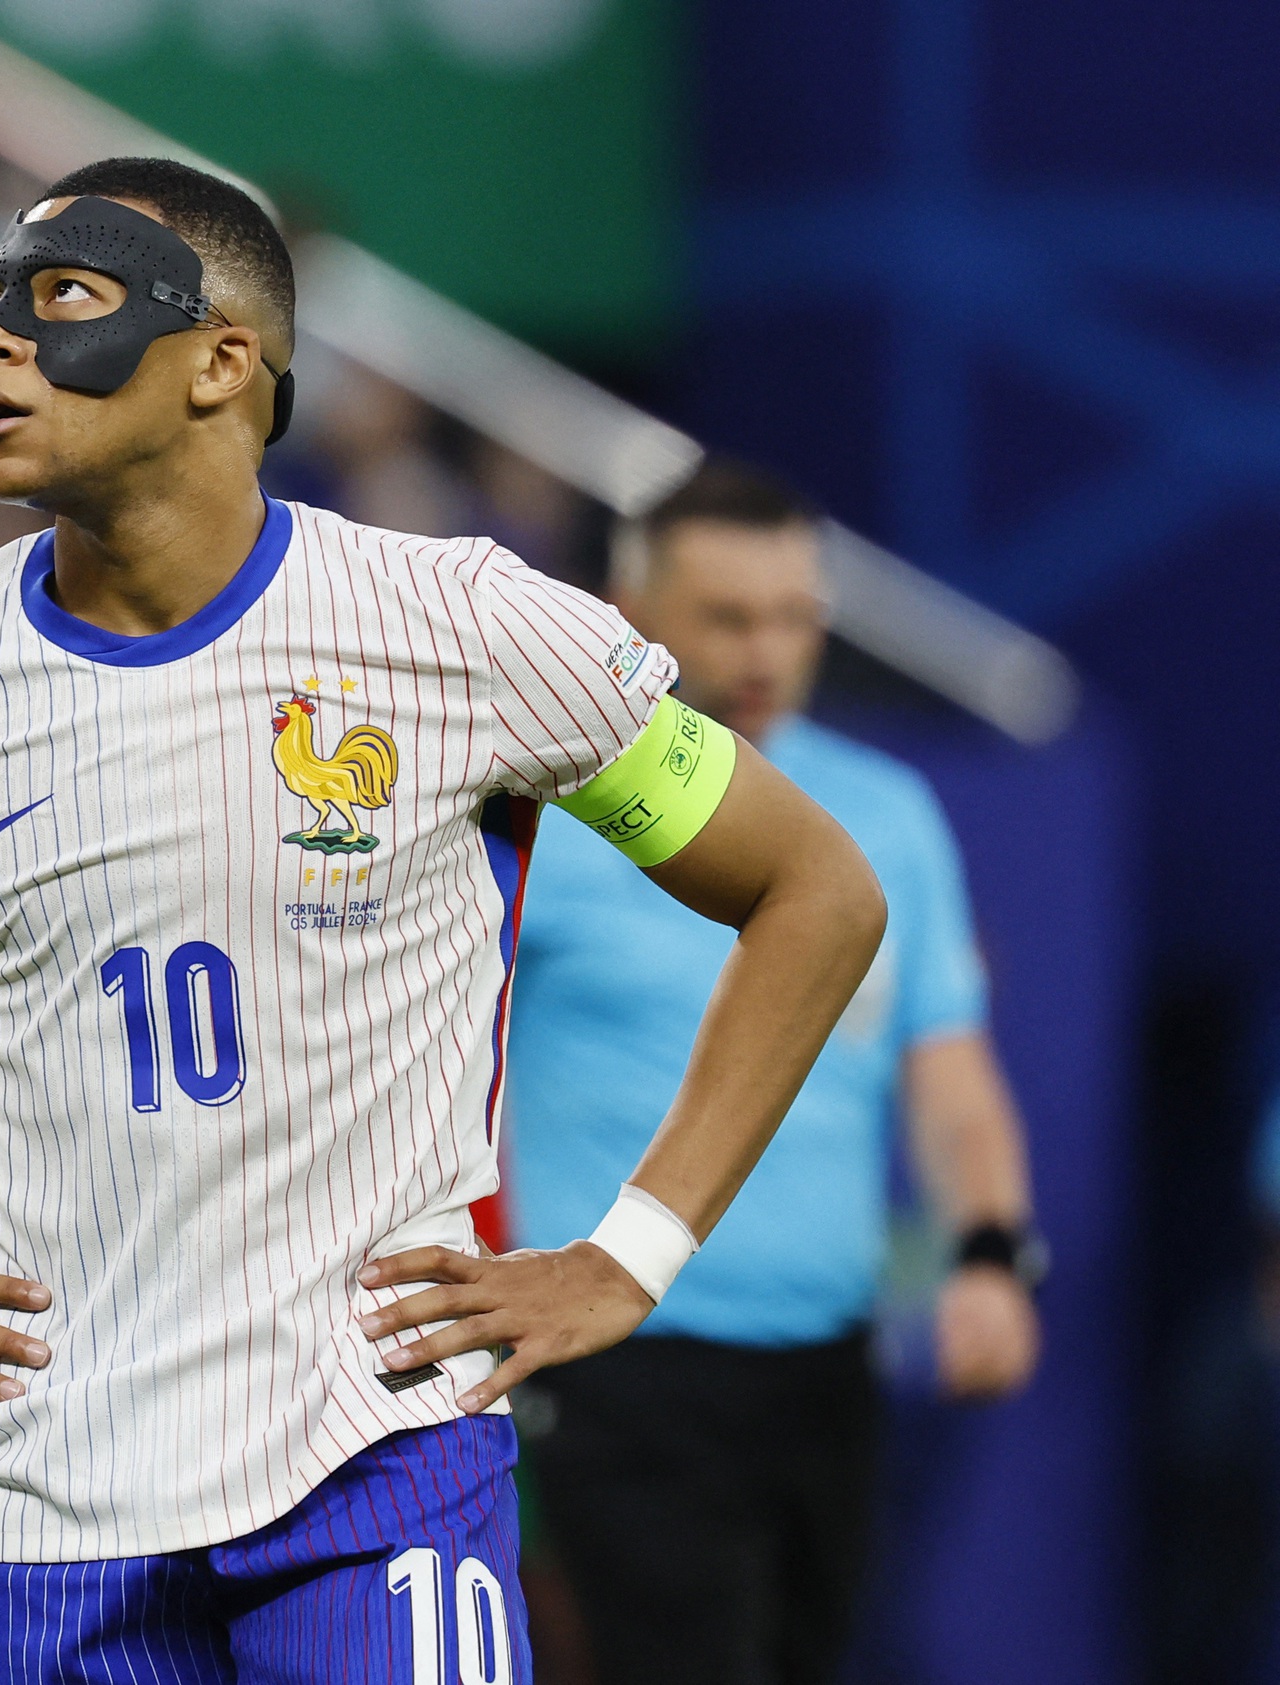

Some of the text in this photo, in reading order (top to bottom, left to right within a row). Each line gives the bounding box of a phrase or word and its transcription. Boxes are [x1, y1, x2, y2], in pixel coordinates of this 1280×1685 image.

[605, 643, 624, 668] UEFA
[285, 903, 337, 916] PORTUGAL
[348, 898, 383, 913] FRANCE
[290, 913, 377, 930] 05 JUILLET 2024
[100, 941, 247, 1114] 10
[387, 1547, 514, 1685] 10
